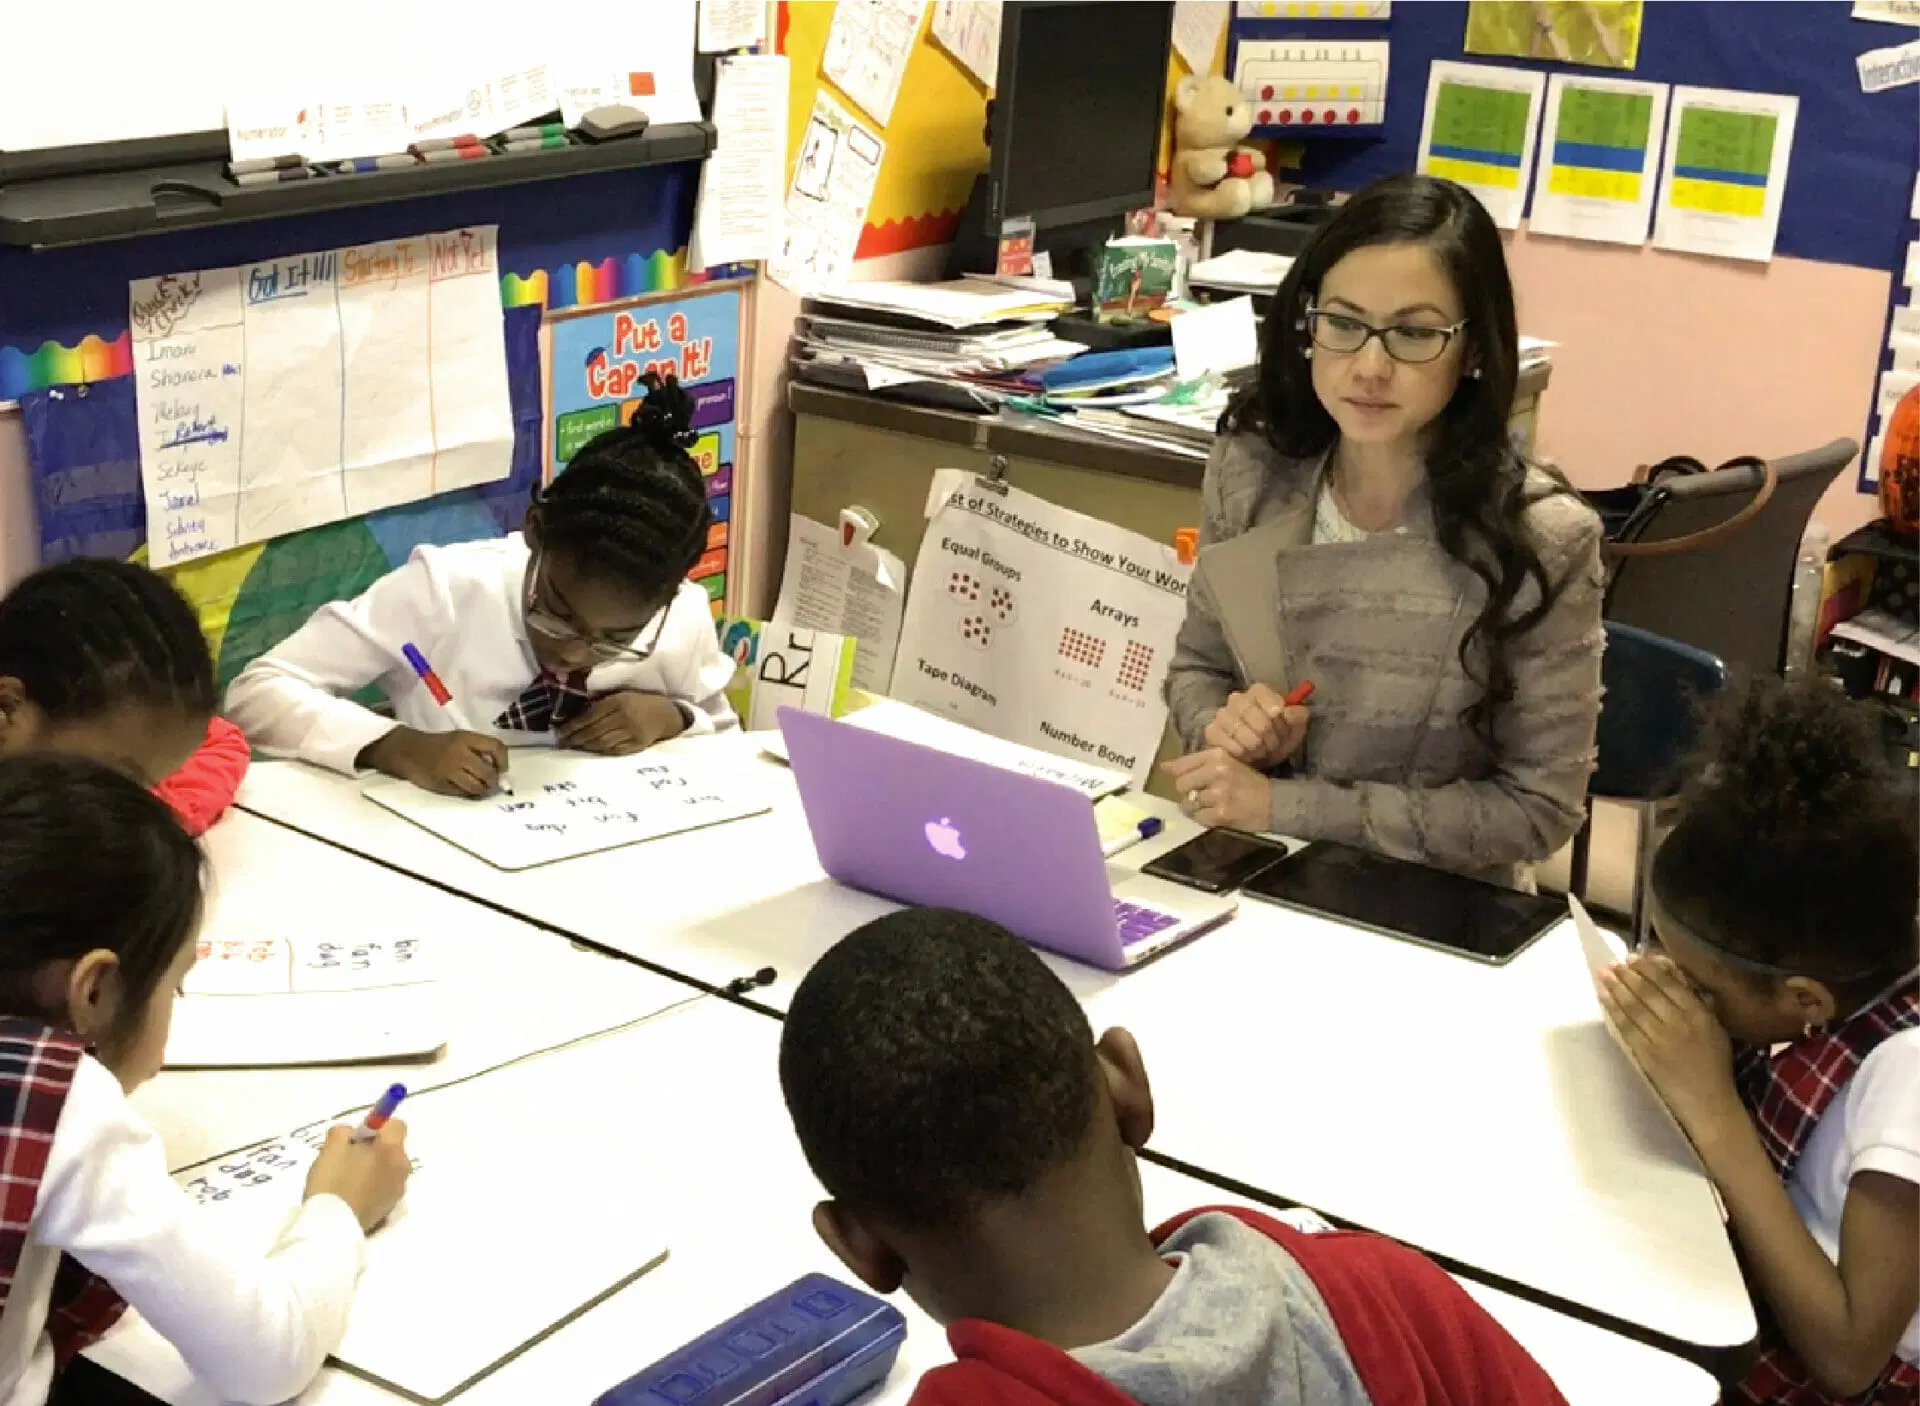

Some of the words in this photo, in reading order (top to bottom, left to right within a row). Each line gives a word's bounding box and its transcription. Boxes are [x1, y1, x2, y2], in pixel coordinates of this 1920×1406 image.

[432, 239, 459, 277] Not
[249, 263, 281, 302] Got
[613, 312, 662, 357] Put
[667, 312, 688, 343] a
[586, 350, 639, 399] Cap
[680, 336, 712, 382] It!
[941, 536, 980, 564] Equal
[981, 551, 1022, 583] Groups
[968, 496, 984, 513] of
[986, 501, 1050, 543] Strategies
[1053, 531, 1070, 550] to
[1074, 538, 1115, 566] Show
[1119, 554, 1152, 580] Your
[1155, 568, 1189, 595] Wor
[1090, 598, 1140, 629] Arrays
[760, 632, 813, 690] Rr
[917, 657, 949, 683] Tape
[1039, 720, 1095, 754] Number
[1097, 744, 1136, 769] Bond
